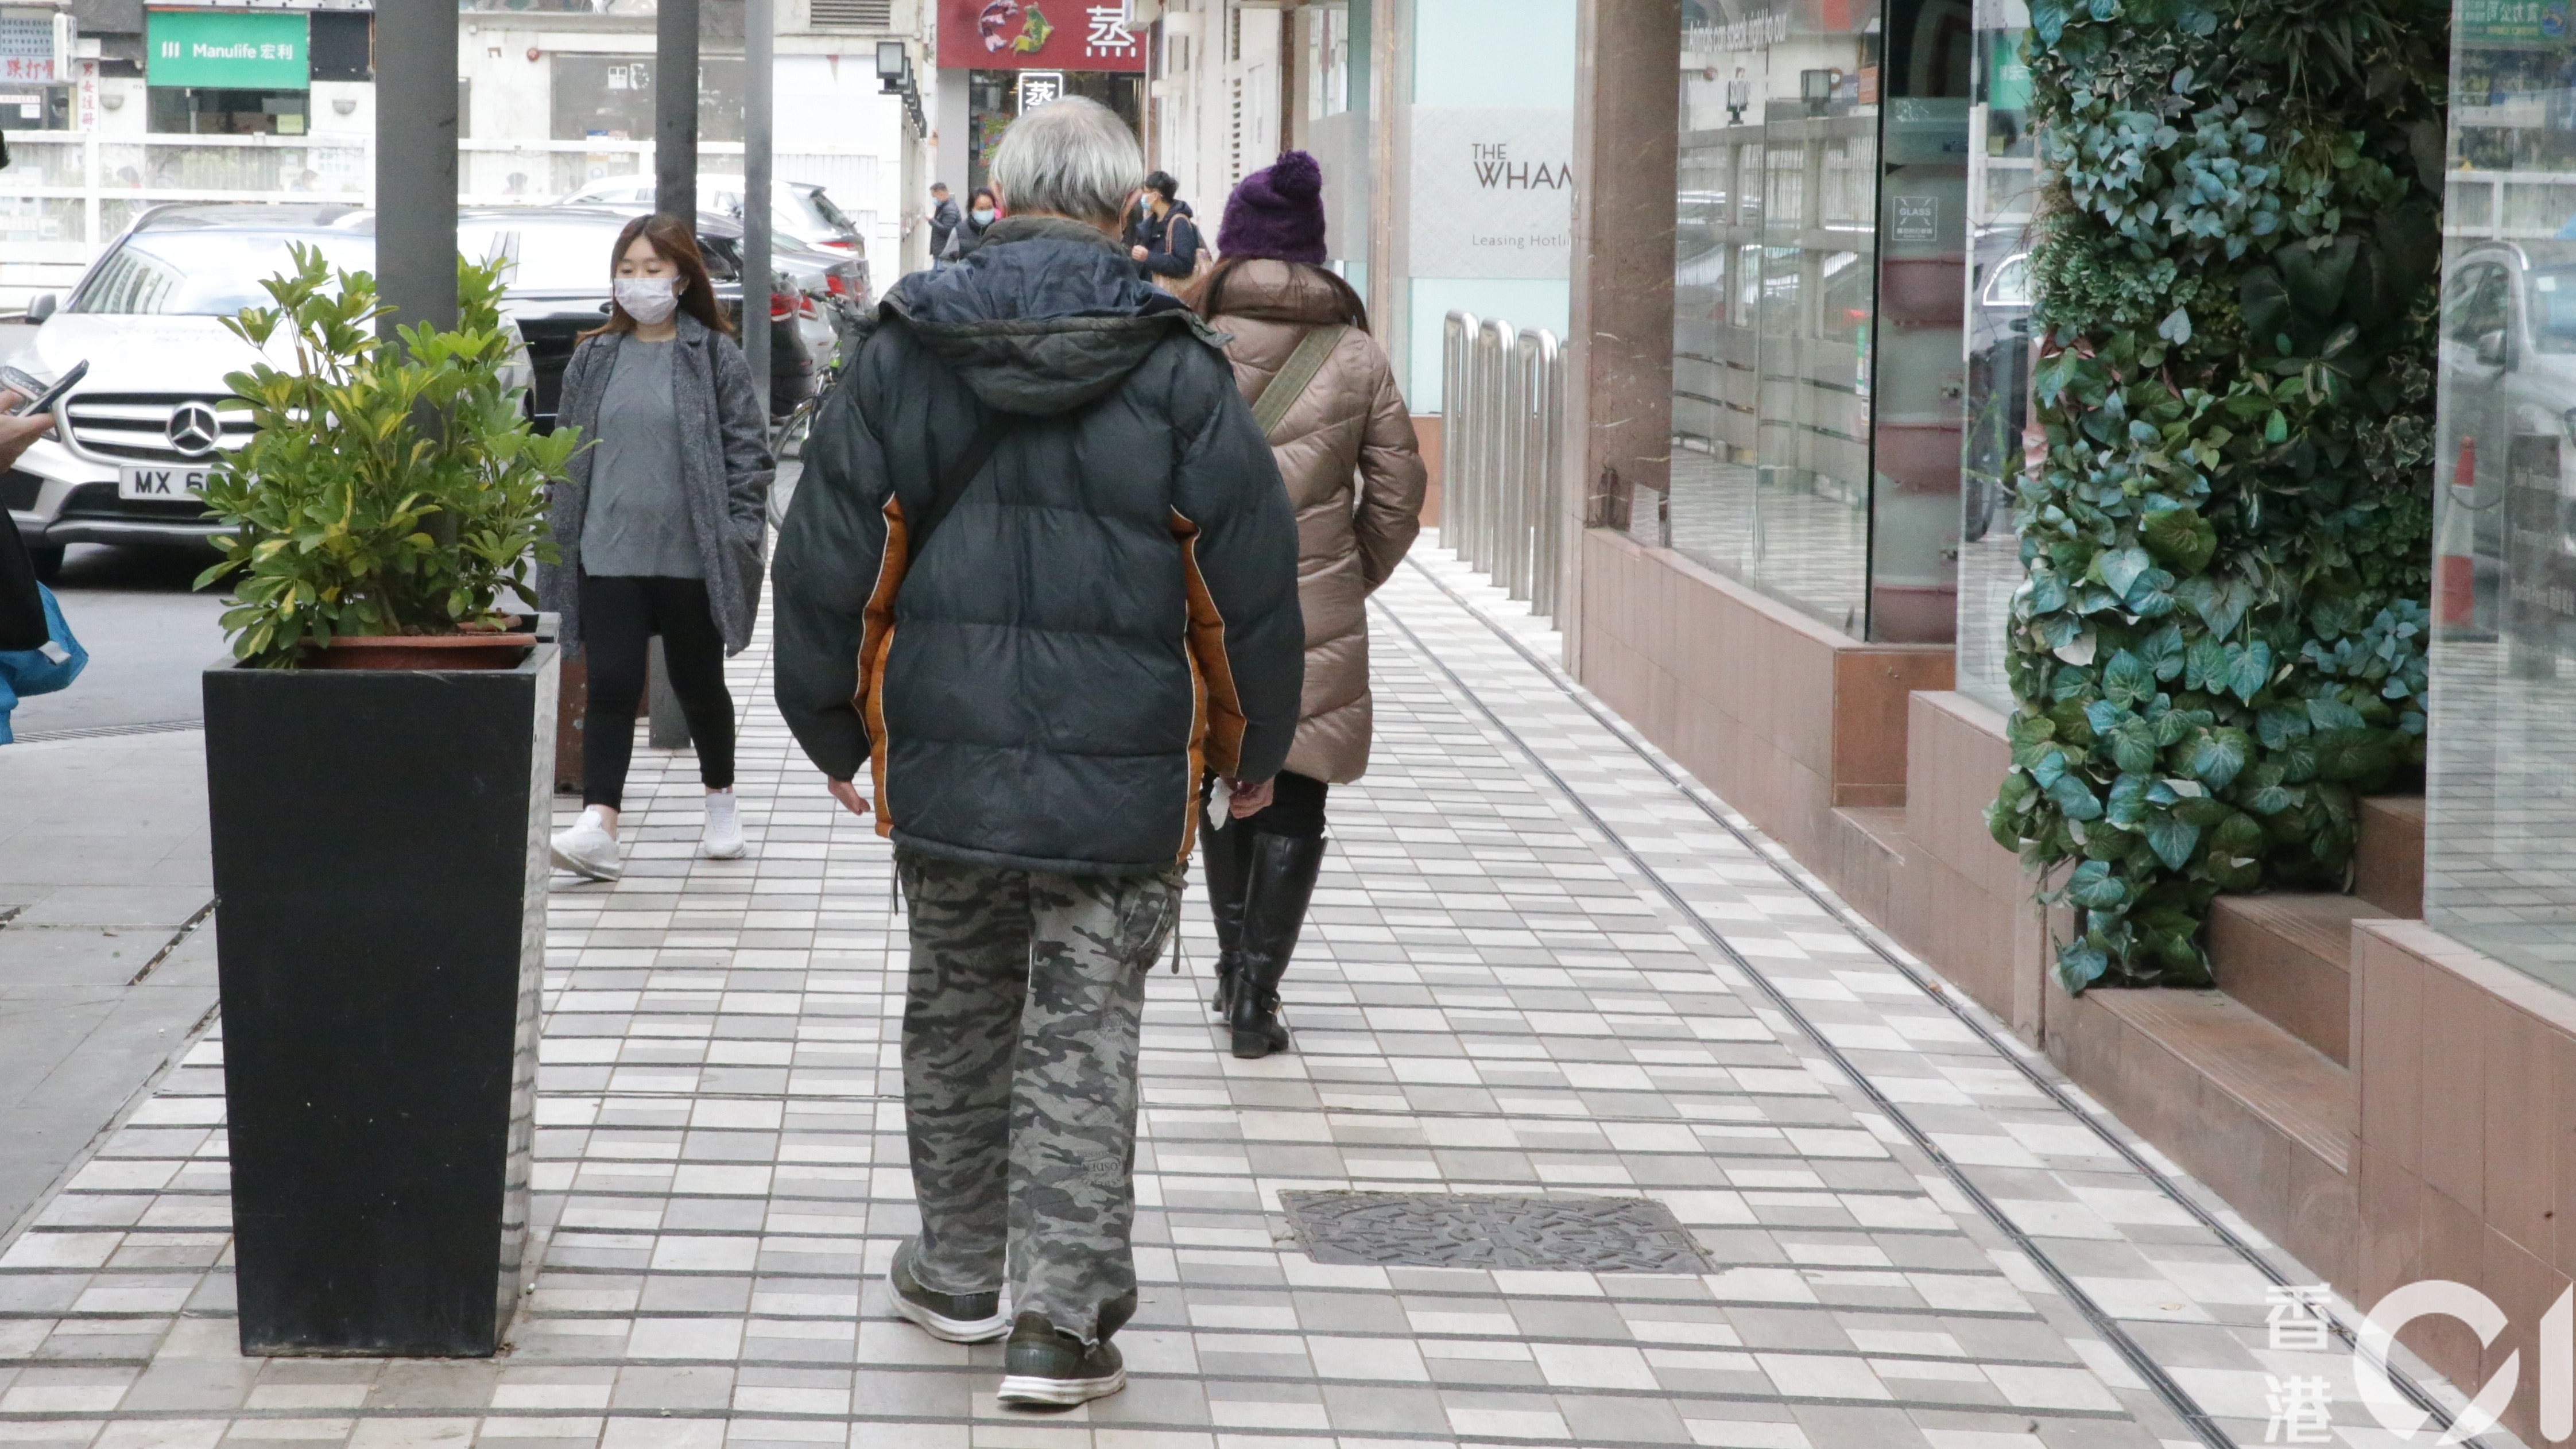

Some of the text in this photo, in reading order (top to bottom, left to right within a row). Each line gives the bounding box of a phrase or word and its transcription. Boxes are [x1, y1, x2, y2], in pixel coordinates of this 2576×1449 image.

[1086, 5, 1136, 57] 蒸
[192, 42, 293, 60] Manulife 宏利
[1472, 144, 1506, 160] THE
[1899, 207, 1931, 216] GLASS
[1473, 234, 1570, 249] Leasing Hotli
[135, 471, 171, 494] MX
